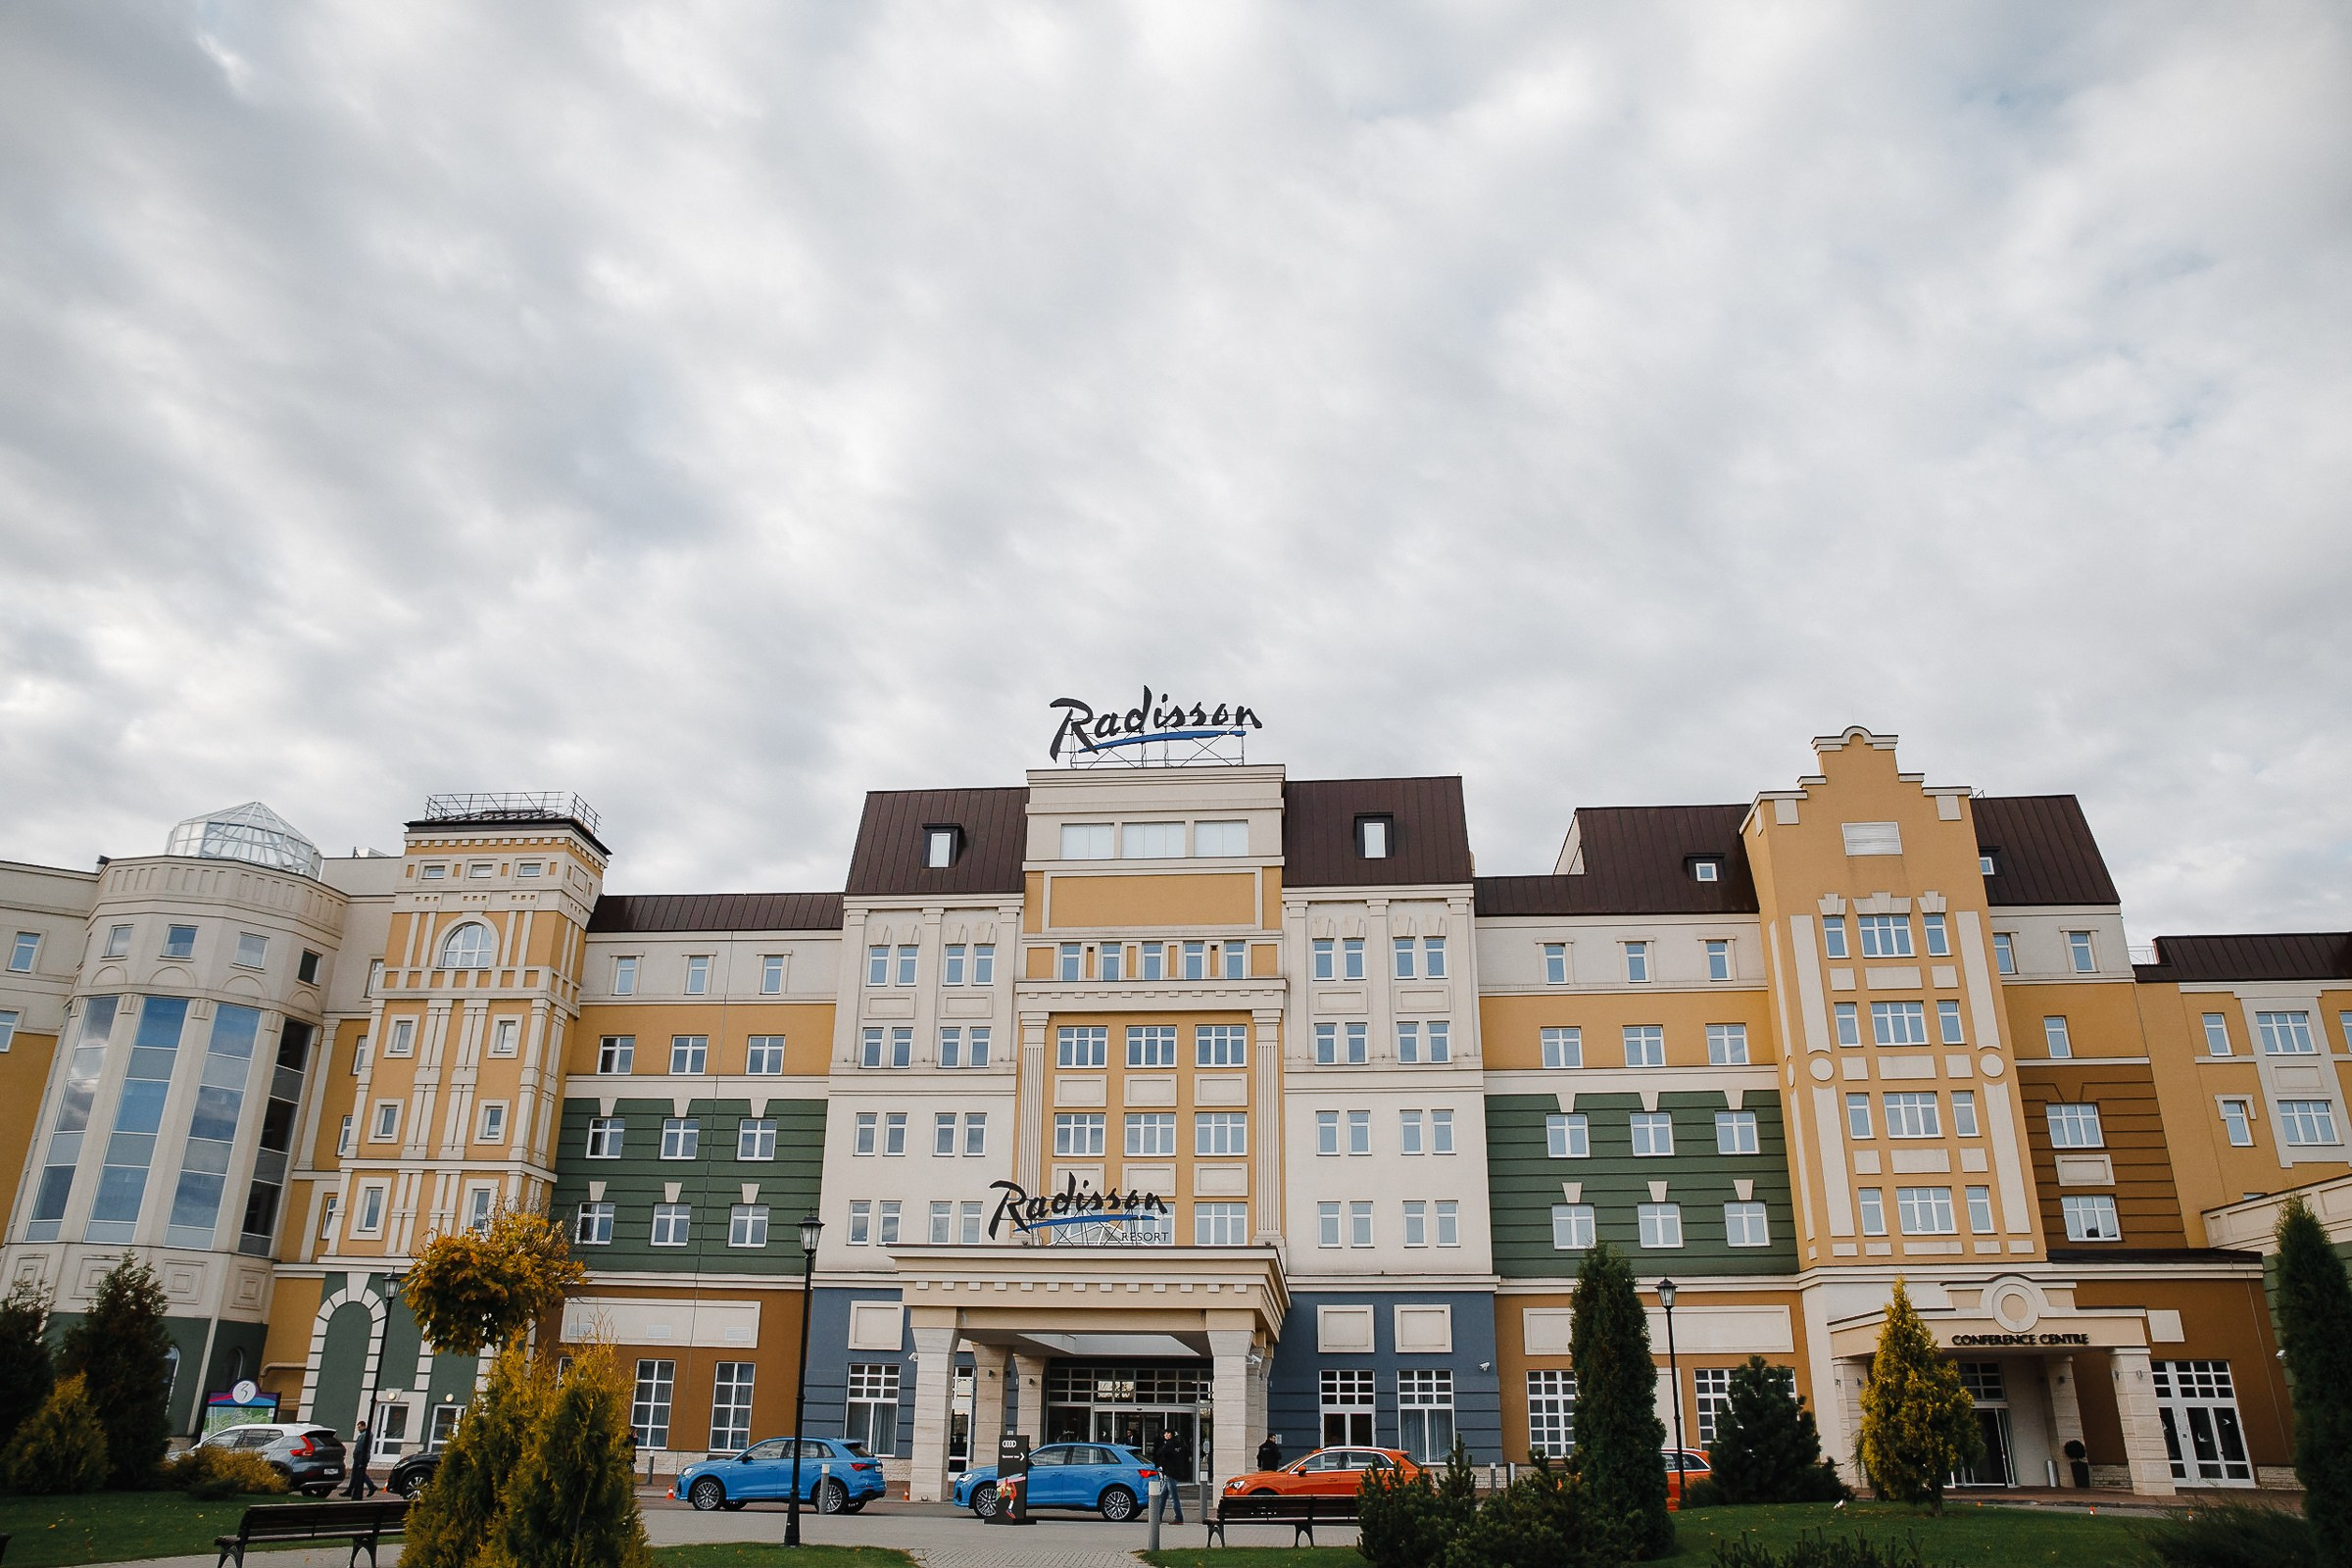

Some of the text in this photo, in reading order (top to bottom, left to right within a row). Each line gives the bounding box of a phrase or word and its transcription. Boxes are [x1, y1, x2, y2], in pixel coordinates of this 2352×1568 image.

[1049, 684, 1263, 763] Radisson
[988, 1171, 1168, 1241] Radisson
[1122, 1231, 1169, 1242] RESORT
[1951, 1333, 2089, 1346] CONFERENCE CENTRE
